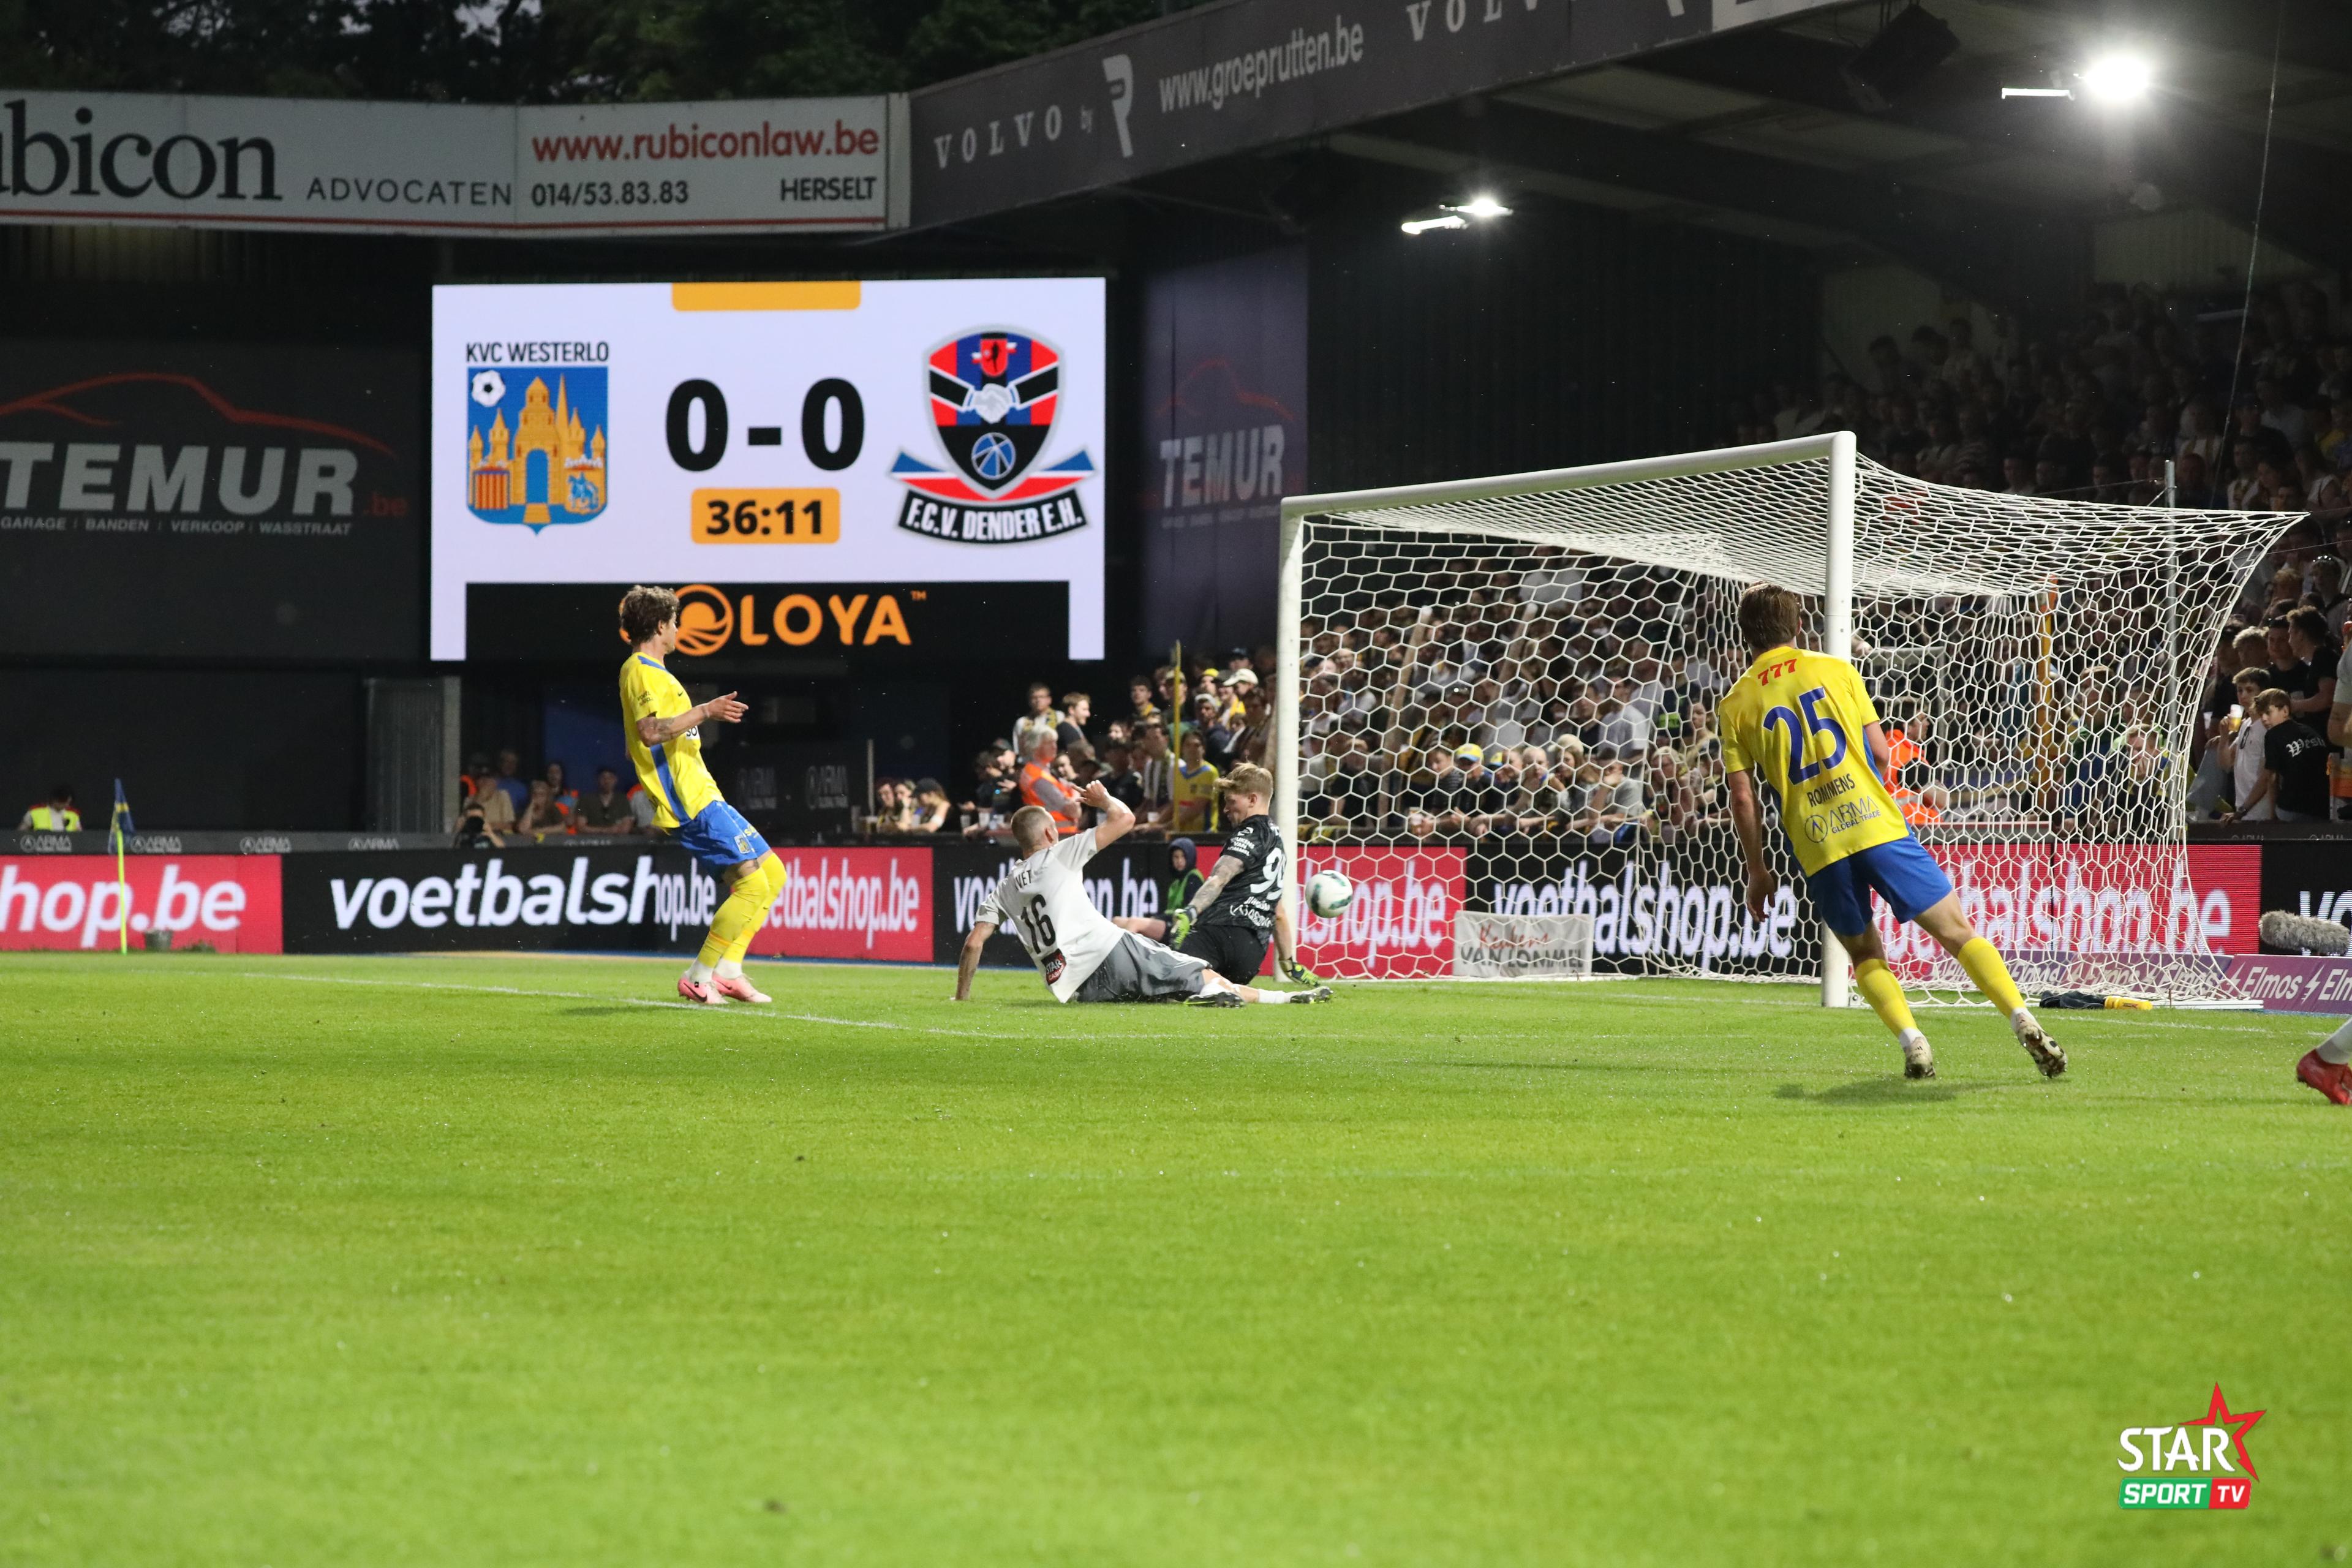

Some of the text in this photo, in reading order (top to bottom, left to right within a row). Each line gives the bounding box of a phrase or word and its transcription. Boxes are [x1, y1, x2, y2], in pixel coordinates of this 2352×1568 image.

[1159, 15, 1364, 113] www.groeprutten.be
[0, 99, 511, 206] bicon ADVOCATEN
[532, 119, 880, 162] www.rubiconlaw.be
[934, 105, 1062, 169] VOLVO
[531, 176, 877, 206] 014/53.83.83 HERSELT
[466, 341, 609, 363] KVC WESTERLO
[0, 441, 358, 516] TEMUR
[1160, 424, 1284, 508] TEMUR
[1, 518, 351, 537] GARAGE BANDEN VERKOOP WASSTRAAT
[706, 500, 822, 535] 36:11
[905, 498, 1083, 540] F.C.V. DENDER E.H.
[1757, 658, 1797, 686] 777
[1763, 687, 1847, 786] 25
[1807, 774, 1855, 808] ROMMENS
[1830, 796, 1878, 825] ARMA
[1831, 809, 1881, 834] GLOBAL TRADE
[330, 855, 717, 942] voetbalshop.be
[1020, 894, 1056, 955] 16
[1046, 959, 1062, 974] STAR
[1460, 946, 1583, 968] VAN LOMMEL
[2242, 967, 2303, 1000] Elmos
